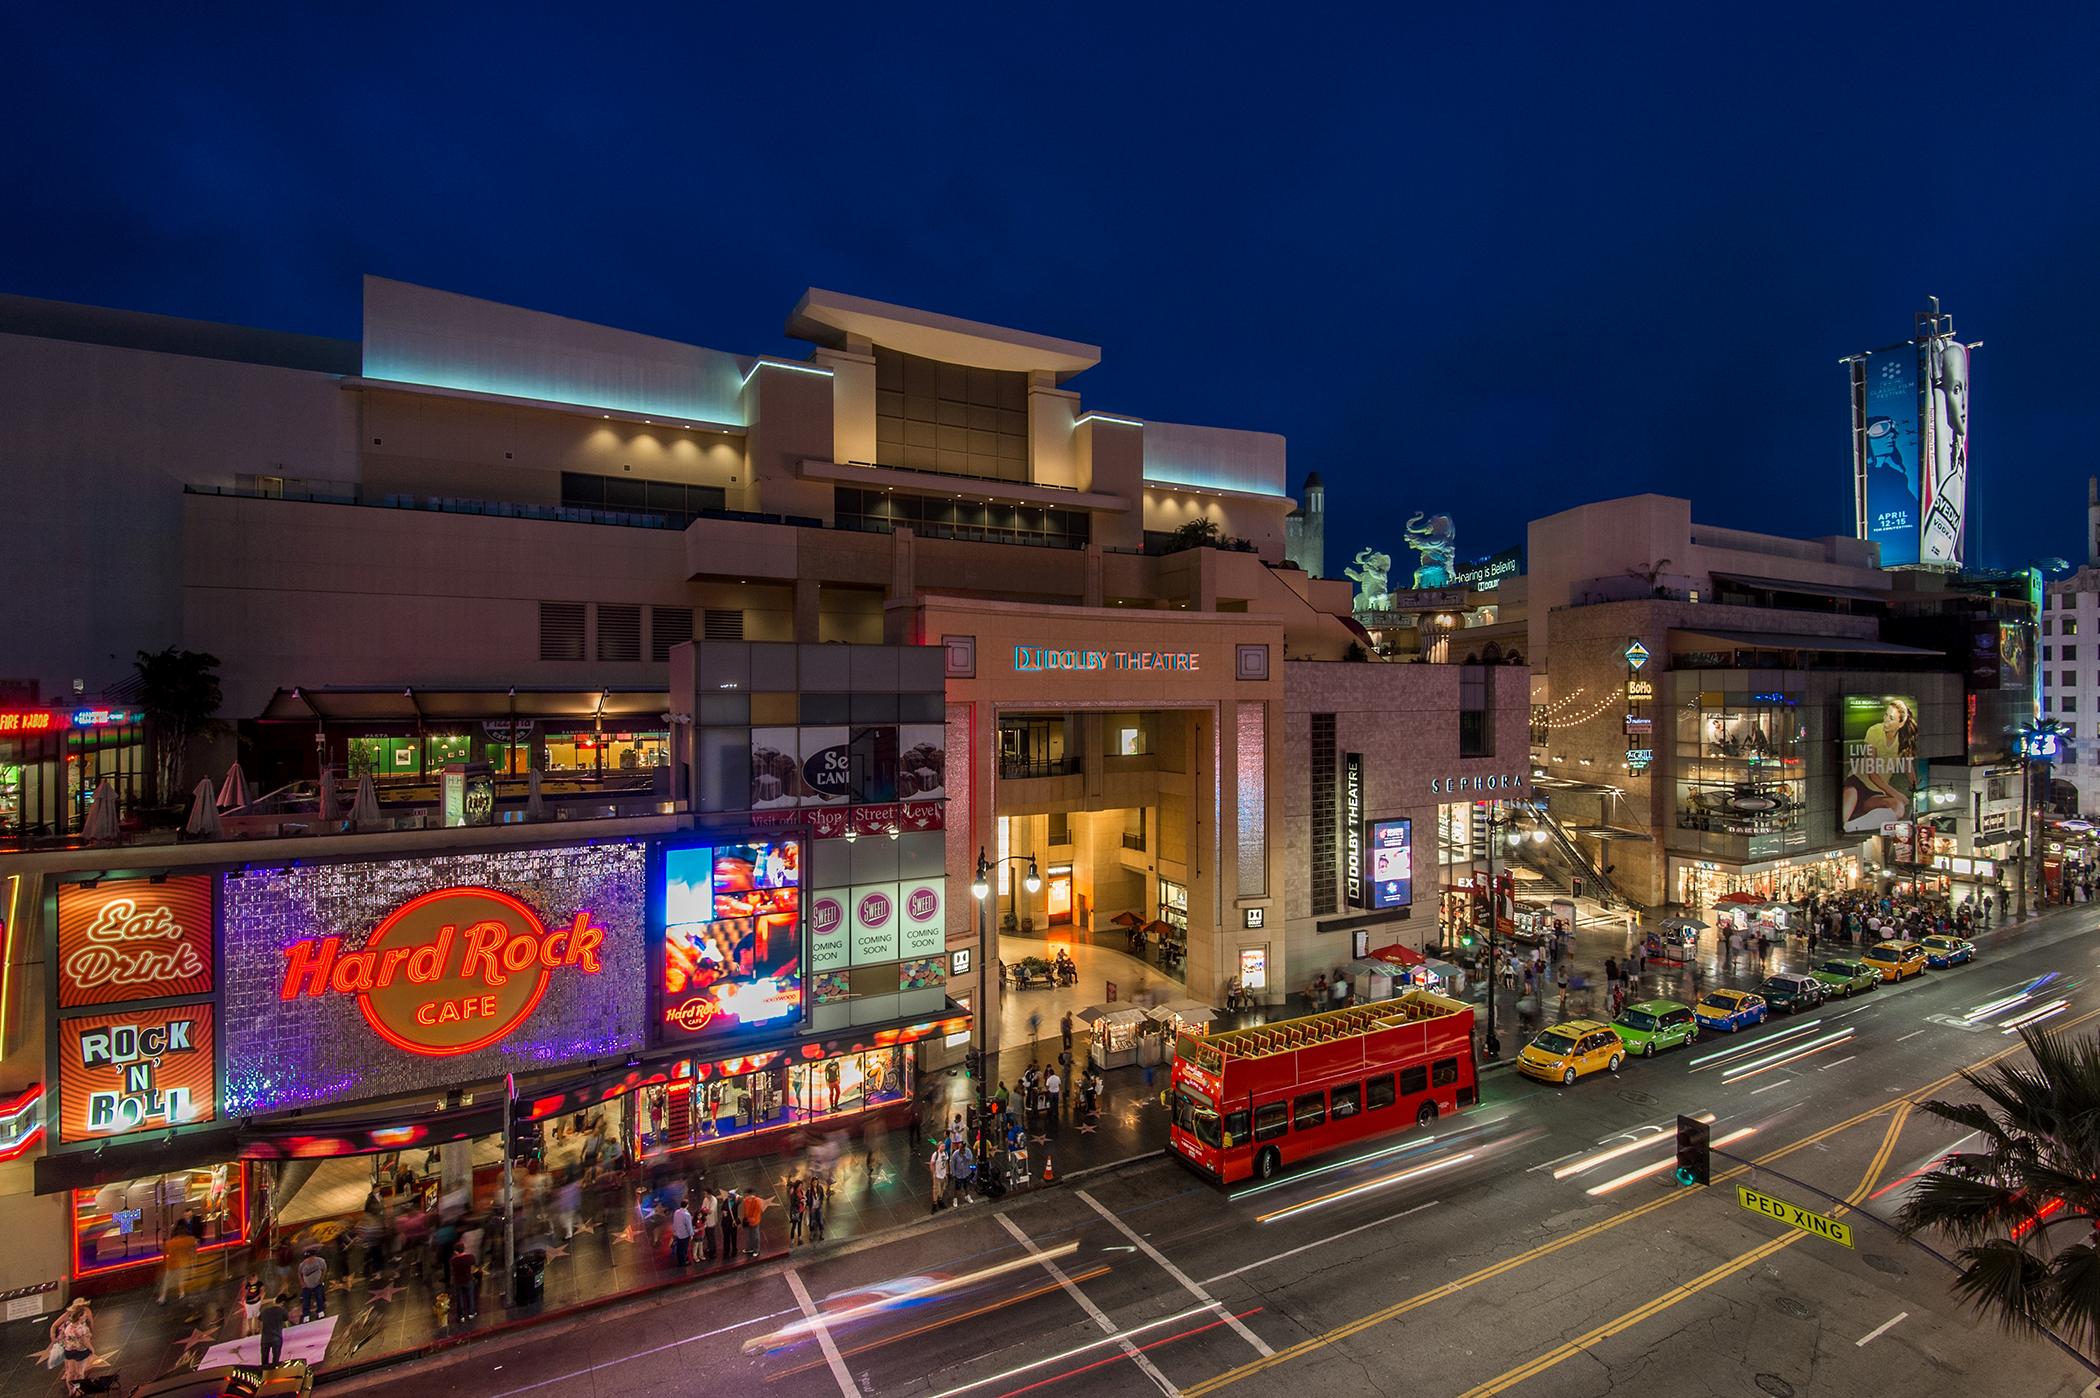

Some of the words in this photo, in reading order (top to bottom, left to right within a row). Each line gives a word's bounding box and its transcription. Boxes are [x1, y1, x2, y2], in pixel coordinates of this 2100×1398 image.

[1878, 511, 1908, 521] APRIL
[1880, 518, 1906, 527] 12-15
[1933, 518, 1953, 541] VODKA
[1454, 569, 1483, 583] Hearing
[1484, 566, 1490, 577] is
[1491, 559, 1516, 576] Believing
[1044, 649, 1109, 670] DOLBY
[1114, 649, 1200, 671] THEATRE
[22, 713, 49, 729] KABOB
[1850, 744, 1873, 756] LIVE
[1849, 757, 1914, 775] VIBRANT
[1348, 762, 1358, 826] THEATRE
[1432, 775, 1522, 794] SEPHORA
[752, 814, 777, 827] Visit
[807, 808, 842, 826] Shop
[856, 807, 894, 822] Street
[1348, 828, 1359, 878] DOLBY
[858, 934, 892, 946] COMING
[906, 928, 940, 939] COMING
[813, 940, 843, 952] OMING
[863, 945, 888, 955] SOON
[911, 939, 935, 949] SOON
[66, 943, 202, 988] Drink
[280, 924, 455, 1000] Hard
[461, 911, 604, 986] Rock
[417, 995, 496, 1025] CAFE
[666, 1005, 695, 1022] Hard
[695, 1001, 722, 1018] Rock
[81, 1021, 194, 1065] ROCK
[1745, 1191, 1786, 1218] PED
[1793, 1208, 1843, 1240] XING
